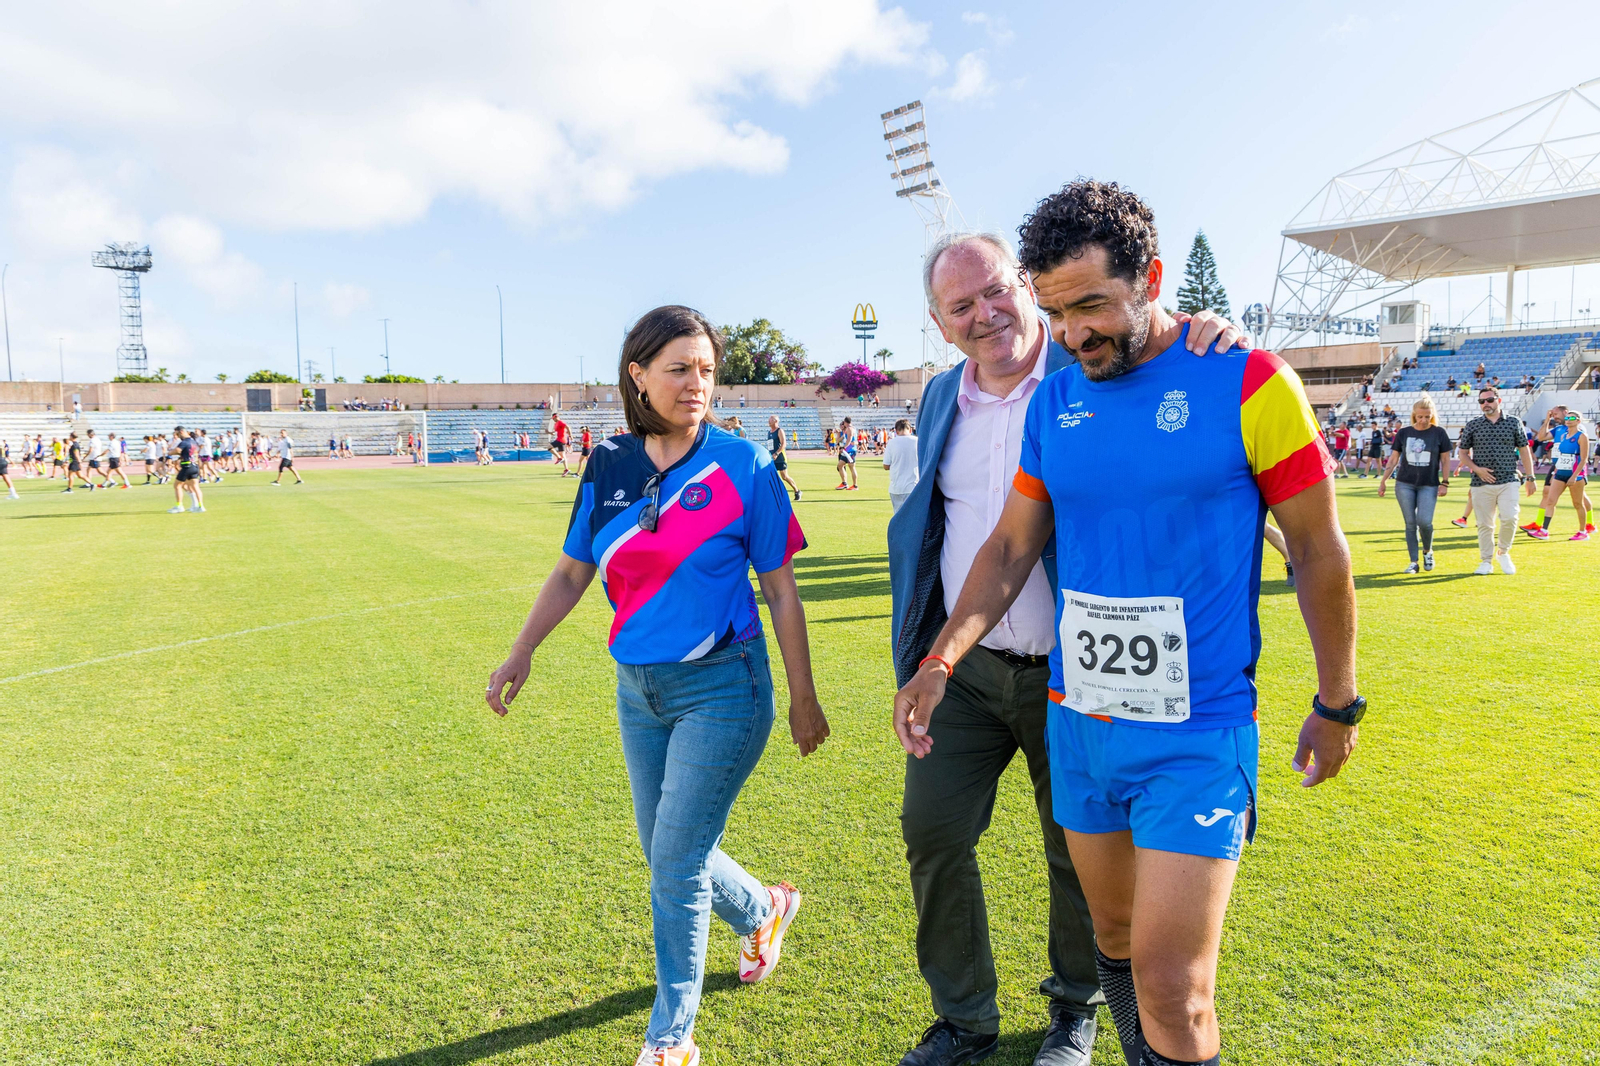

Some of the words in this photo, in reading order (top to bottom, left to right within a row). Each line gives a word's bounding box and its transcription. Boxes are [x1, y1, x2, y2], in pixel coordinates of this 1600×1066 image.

[1061, 419, 1081, 428] CNP
[1089, 603, 1110, 612] SARGENTO
[1119, 605, 1150, 613] INFANTERÍA
[1087, 611, 1101, 619] RAFAEL
[1102, 612, 1125, 621] CARMONA
[1126, 613, 1140, 621] PÁEZ
[1077, 630, 1158, 676] 329
